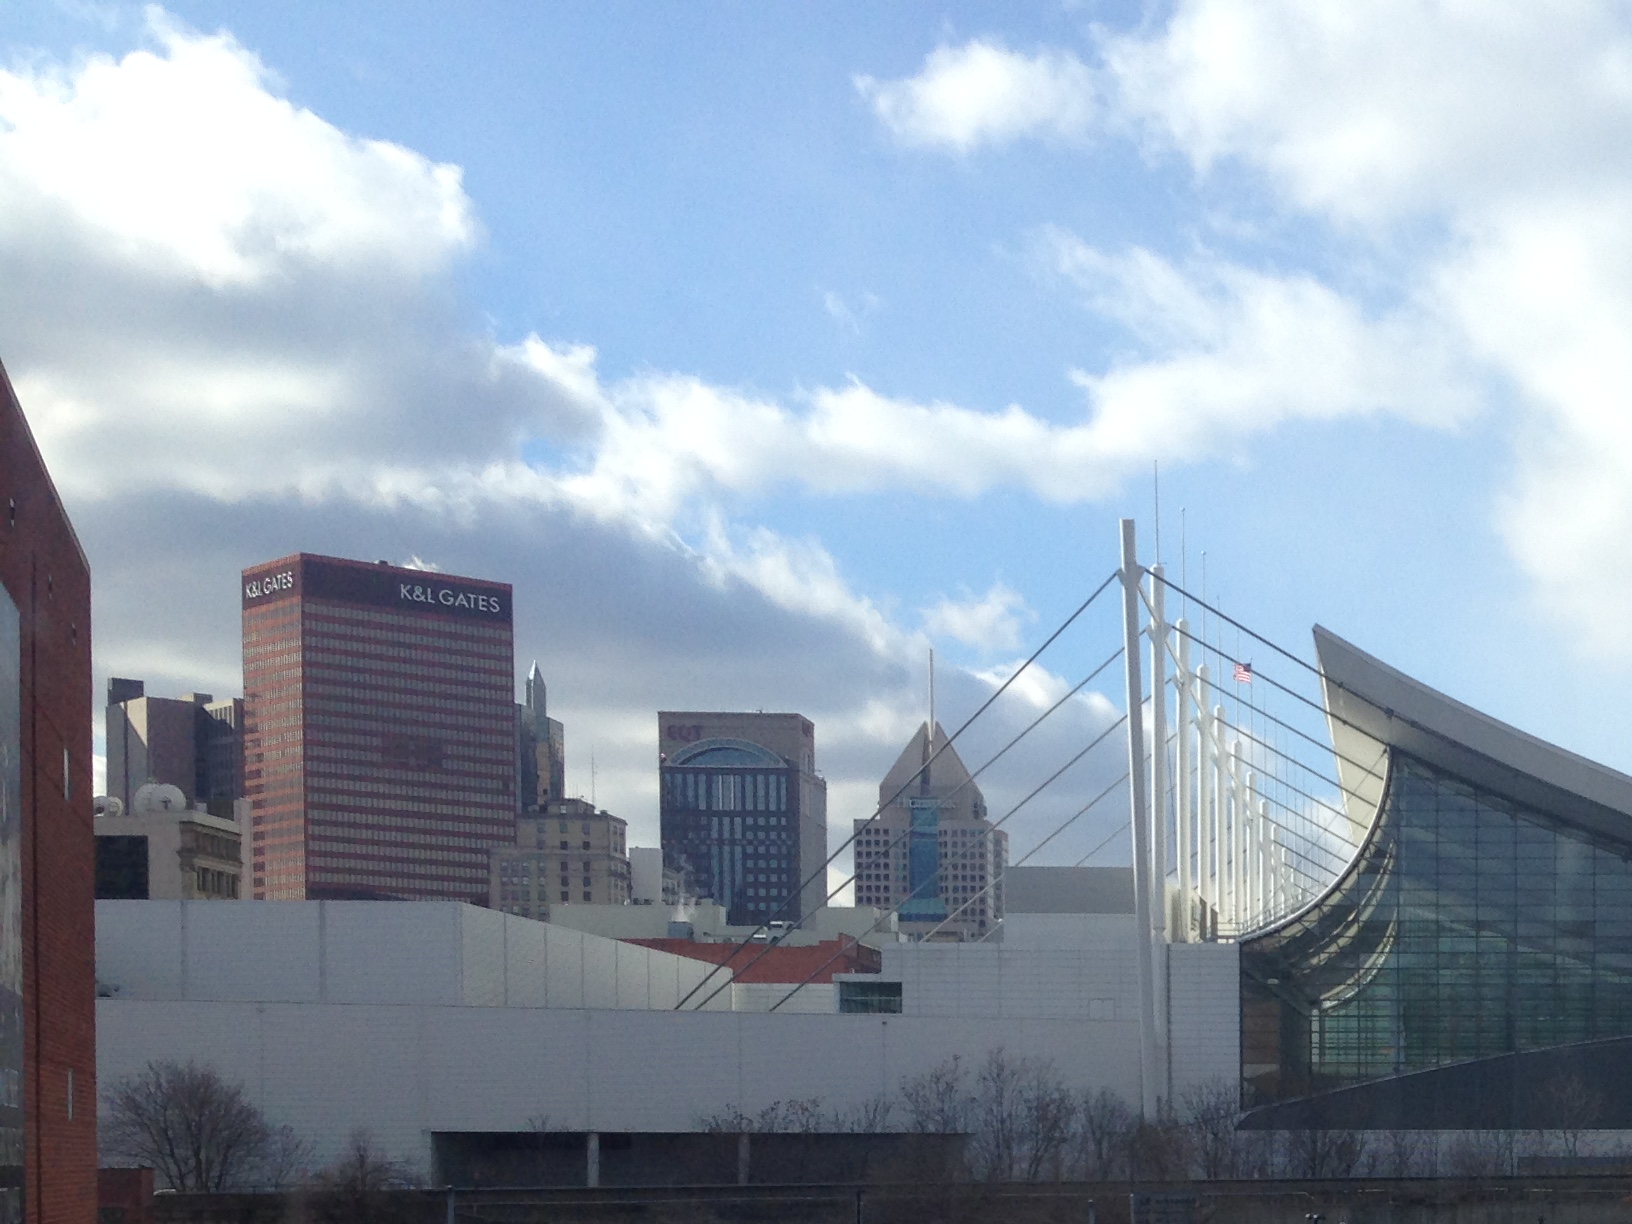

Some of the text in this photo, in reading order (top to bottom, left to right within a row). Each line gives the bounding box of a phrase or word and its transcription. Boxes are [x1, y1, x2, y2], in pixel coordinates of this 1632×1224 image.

[246, 571, 293, 598] K&L GATES
[400, 583, 500, 613] K&L GATES
